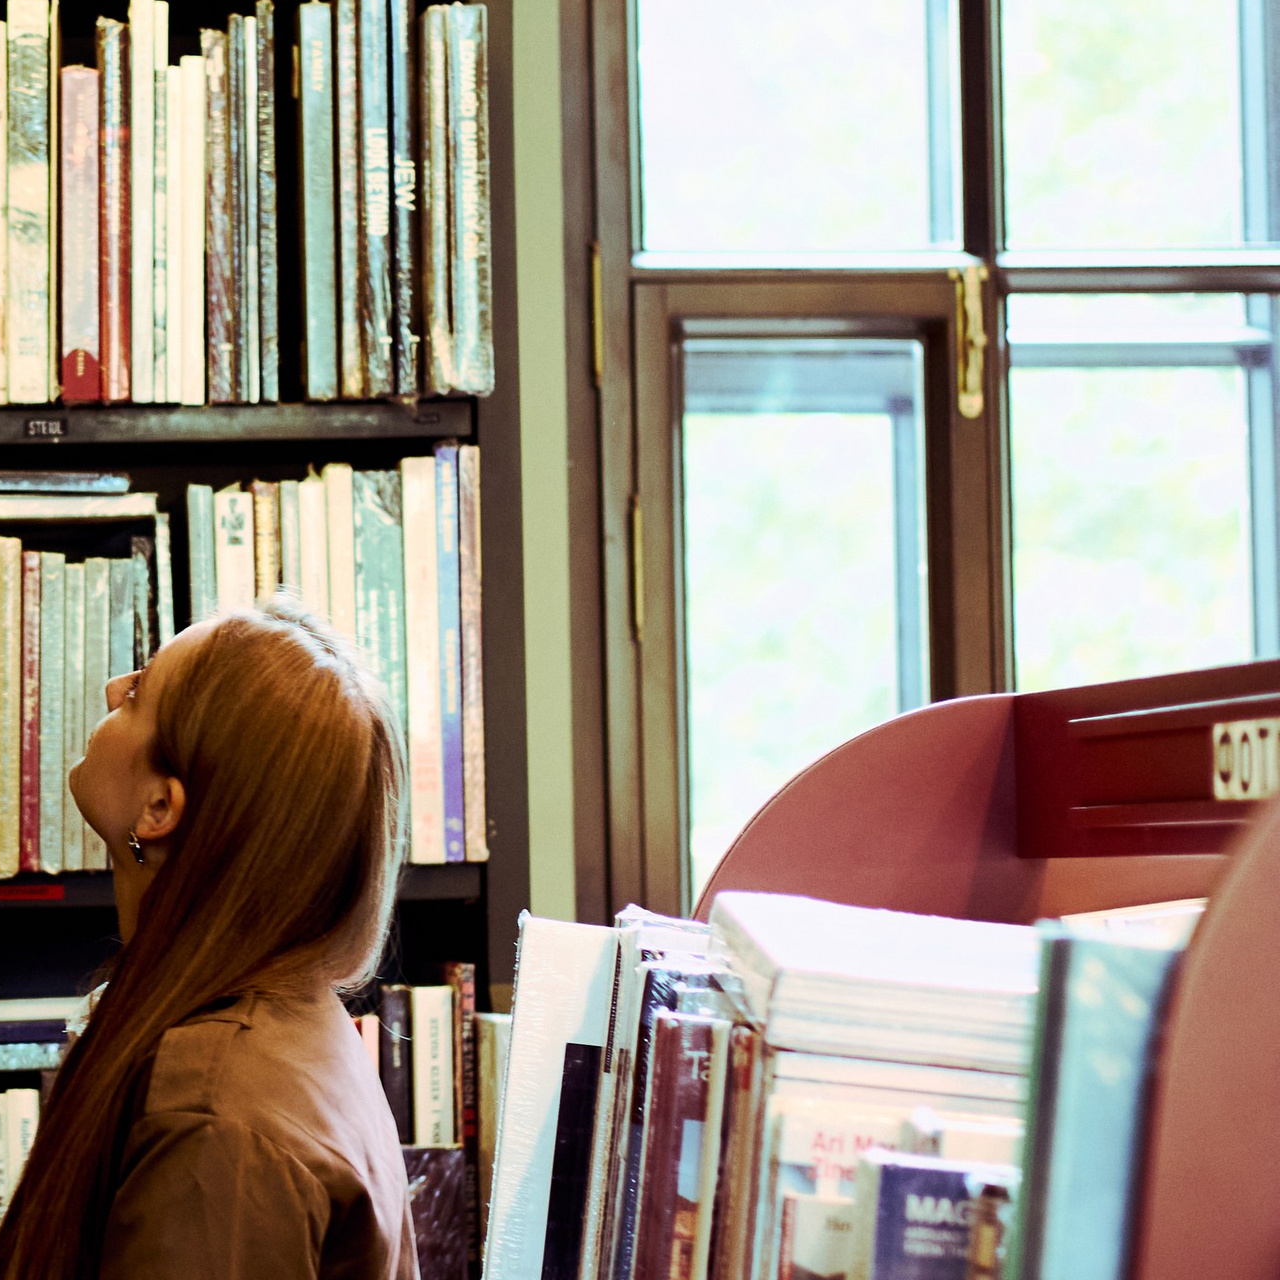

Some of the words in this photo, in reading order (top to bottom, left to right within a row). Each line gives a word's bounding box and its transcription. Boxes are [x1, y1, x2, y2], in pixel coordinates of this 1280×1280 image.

[311, 39, 324, 93] FAMILY
[458, 39, 476, 116] EDWARD
[365, 127, 386, 170] LOOK
[460, 120, 478, 229] BURTYNSKY
[365, 172, 389, 236] BEYOND
[393, 153, 416, 211] JEW
[28, 421, 64, 436] STEIDL
[463, 1041, 475, 1106] STATION
